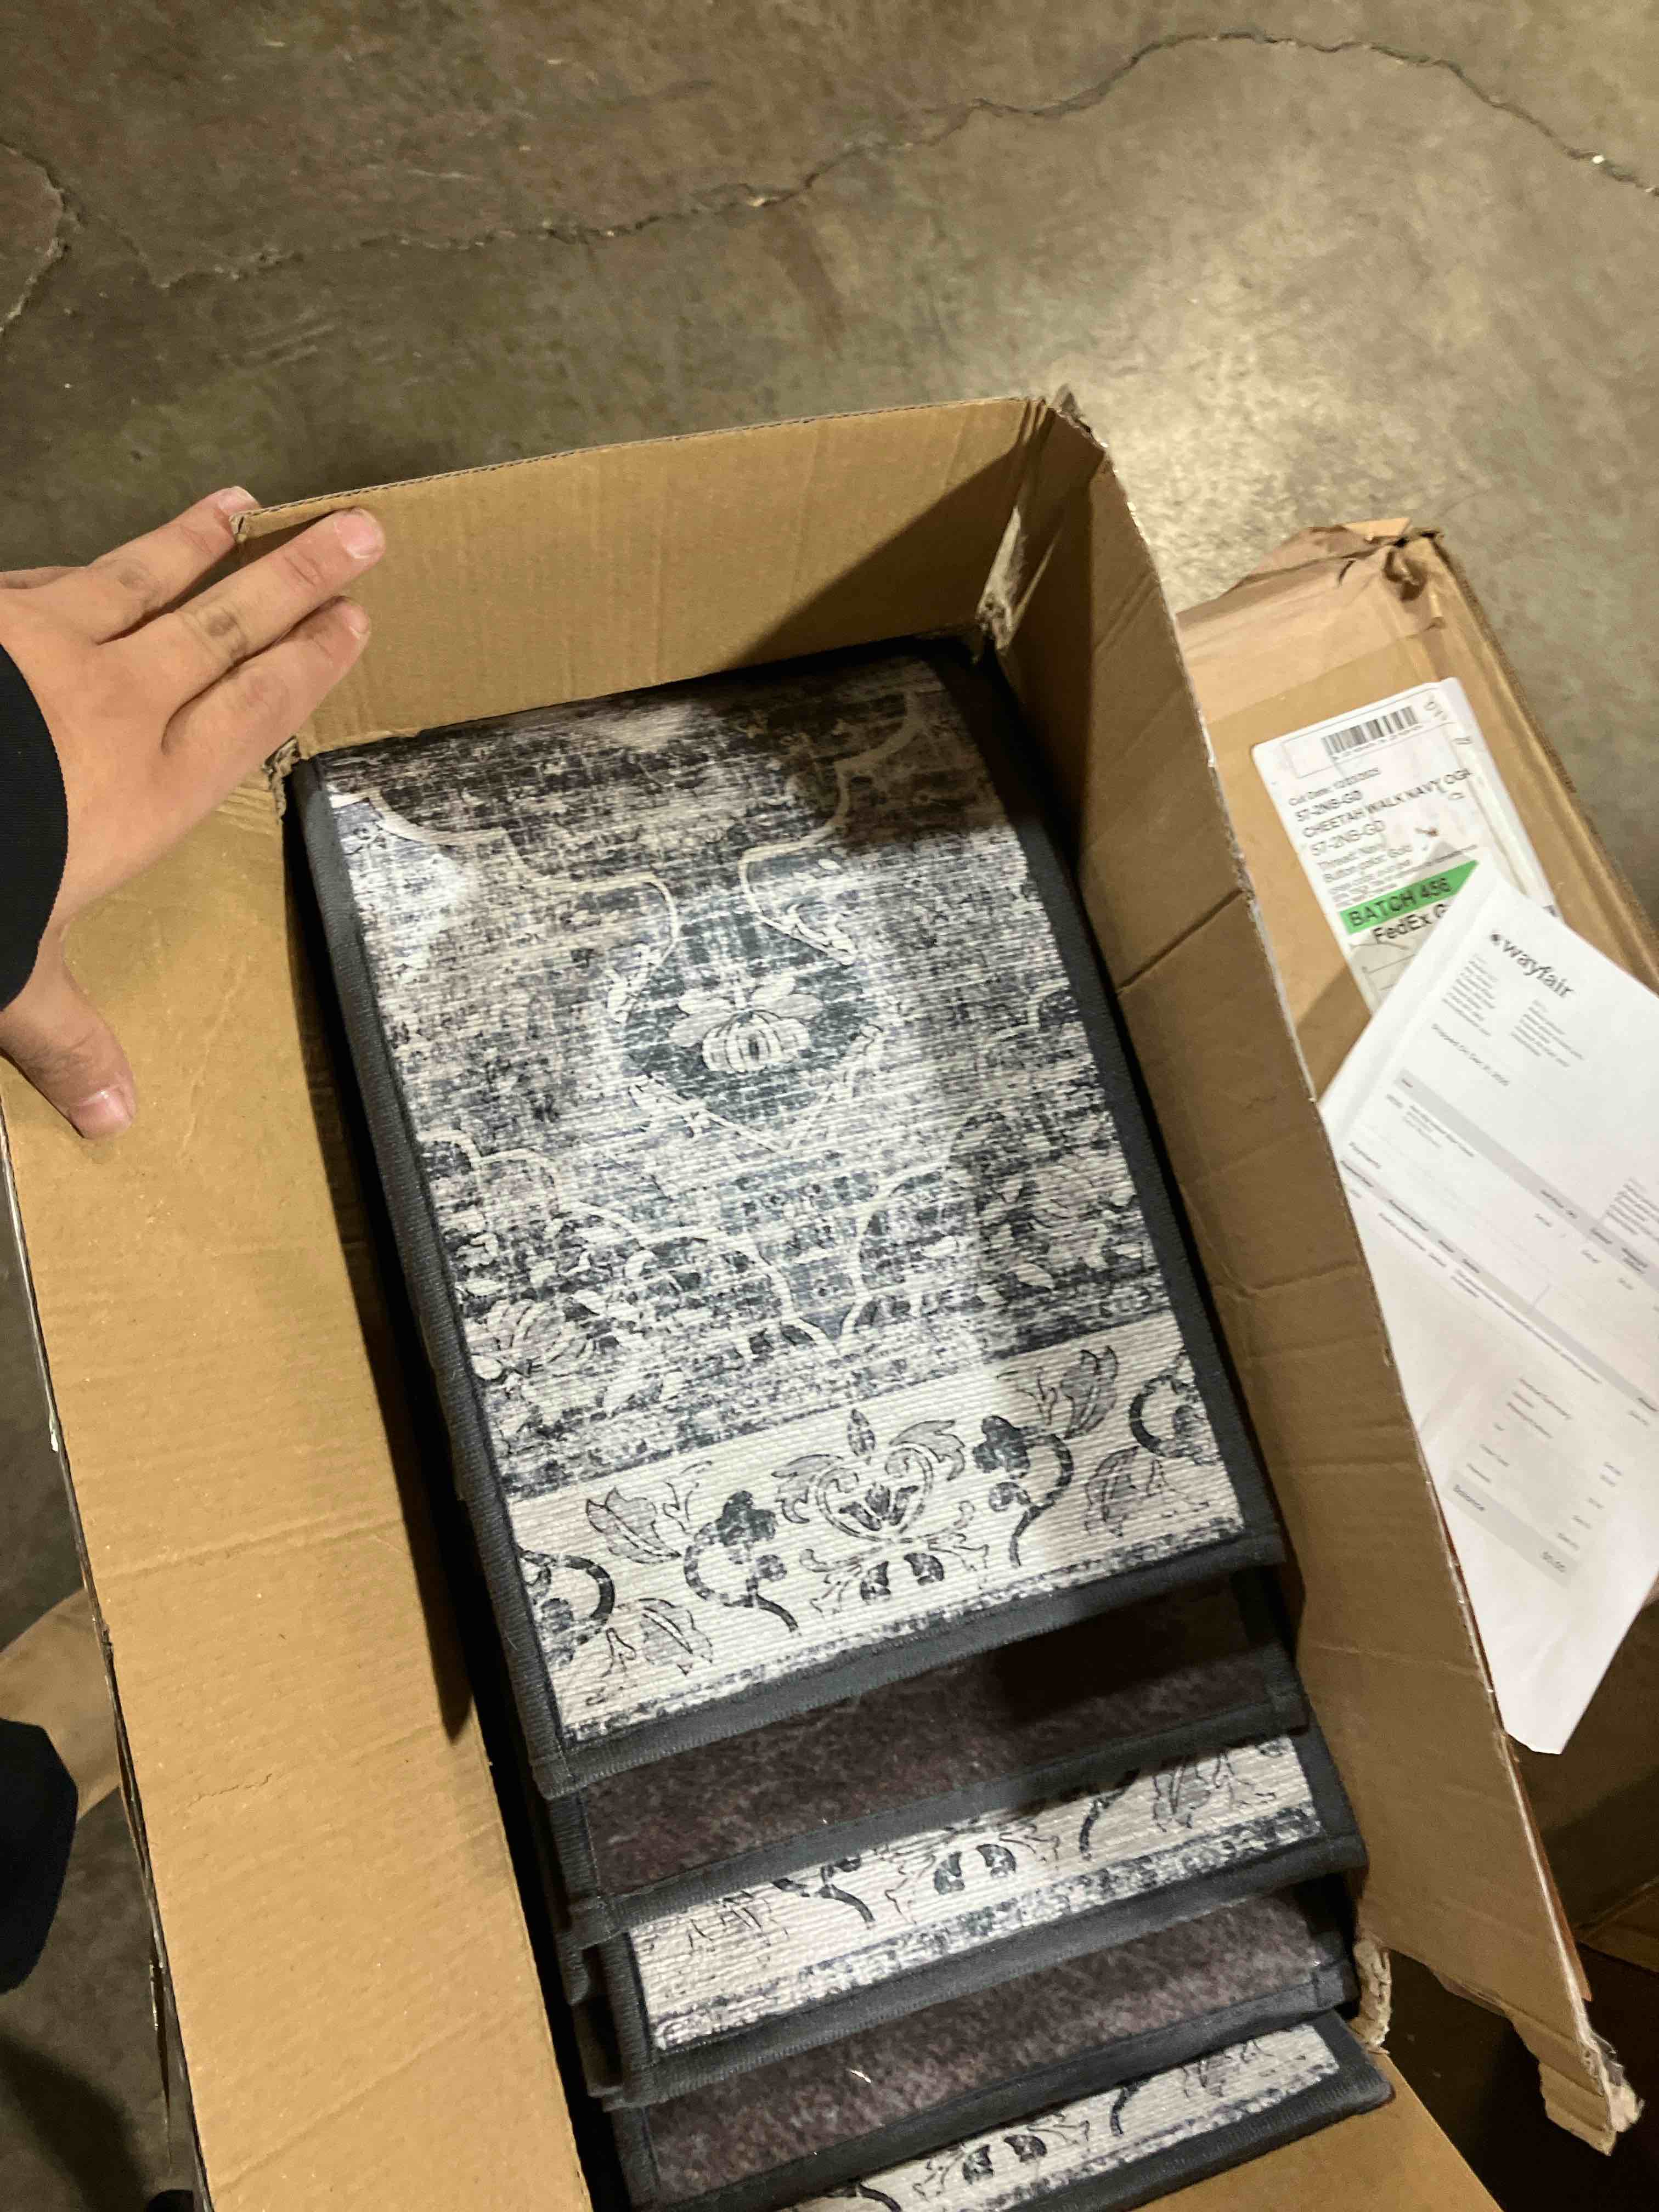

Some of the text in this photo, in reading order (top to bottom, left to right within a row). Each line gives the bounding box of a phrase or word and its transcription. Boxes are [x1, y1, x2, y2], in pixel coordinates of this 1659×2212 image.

[1348, 889, 1417, 928] BATCH
[1373, 912, 1433, 945] FedEx
[1503, 938, 1573, 998] wayfair
